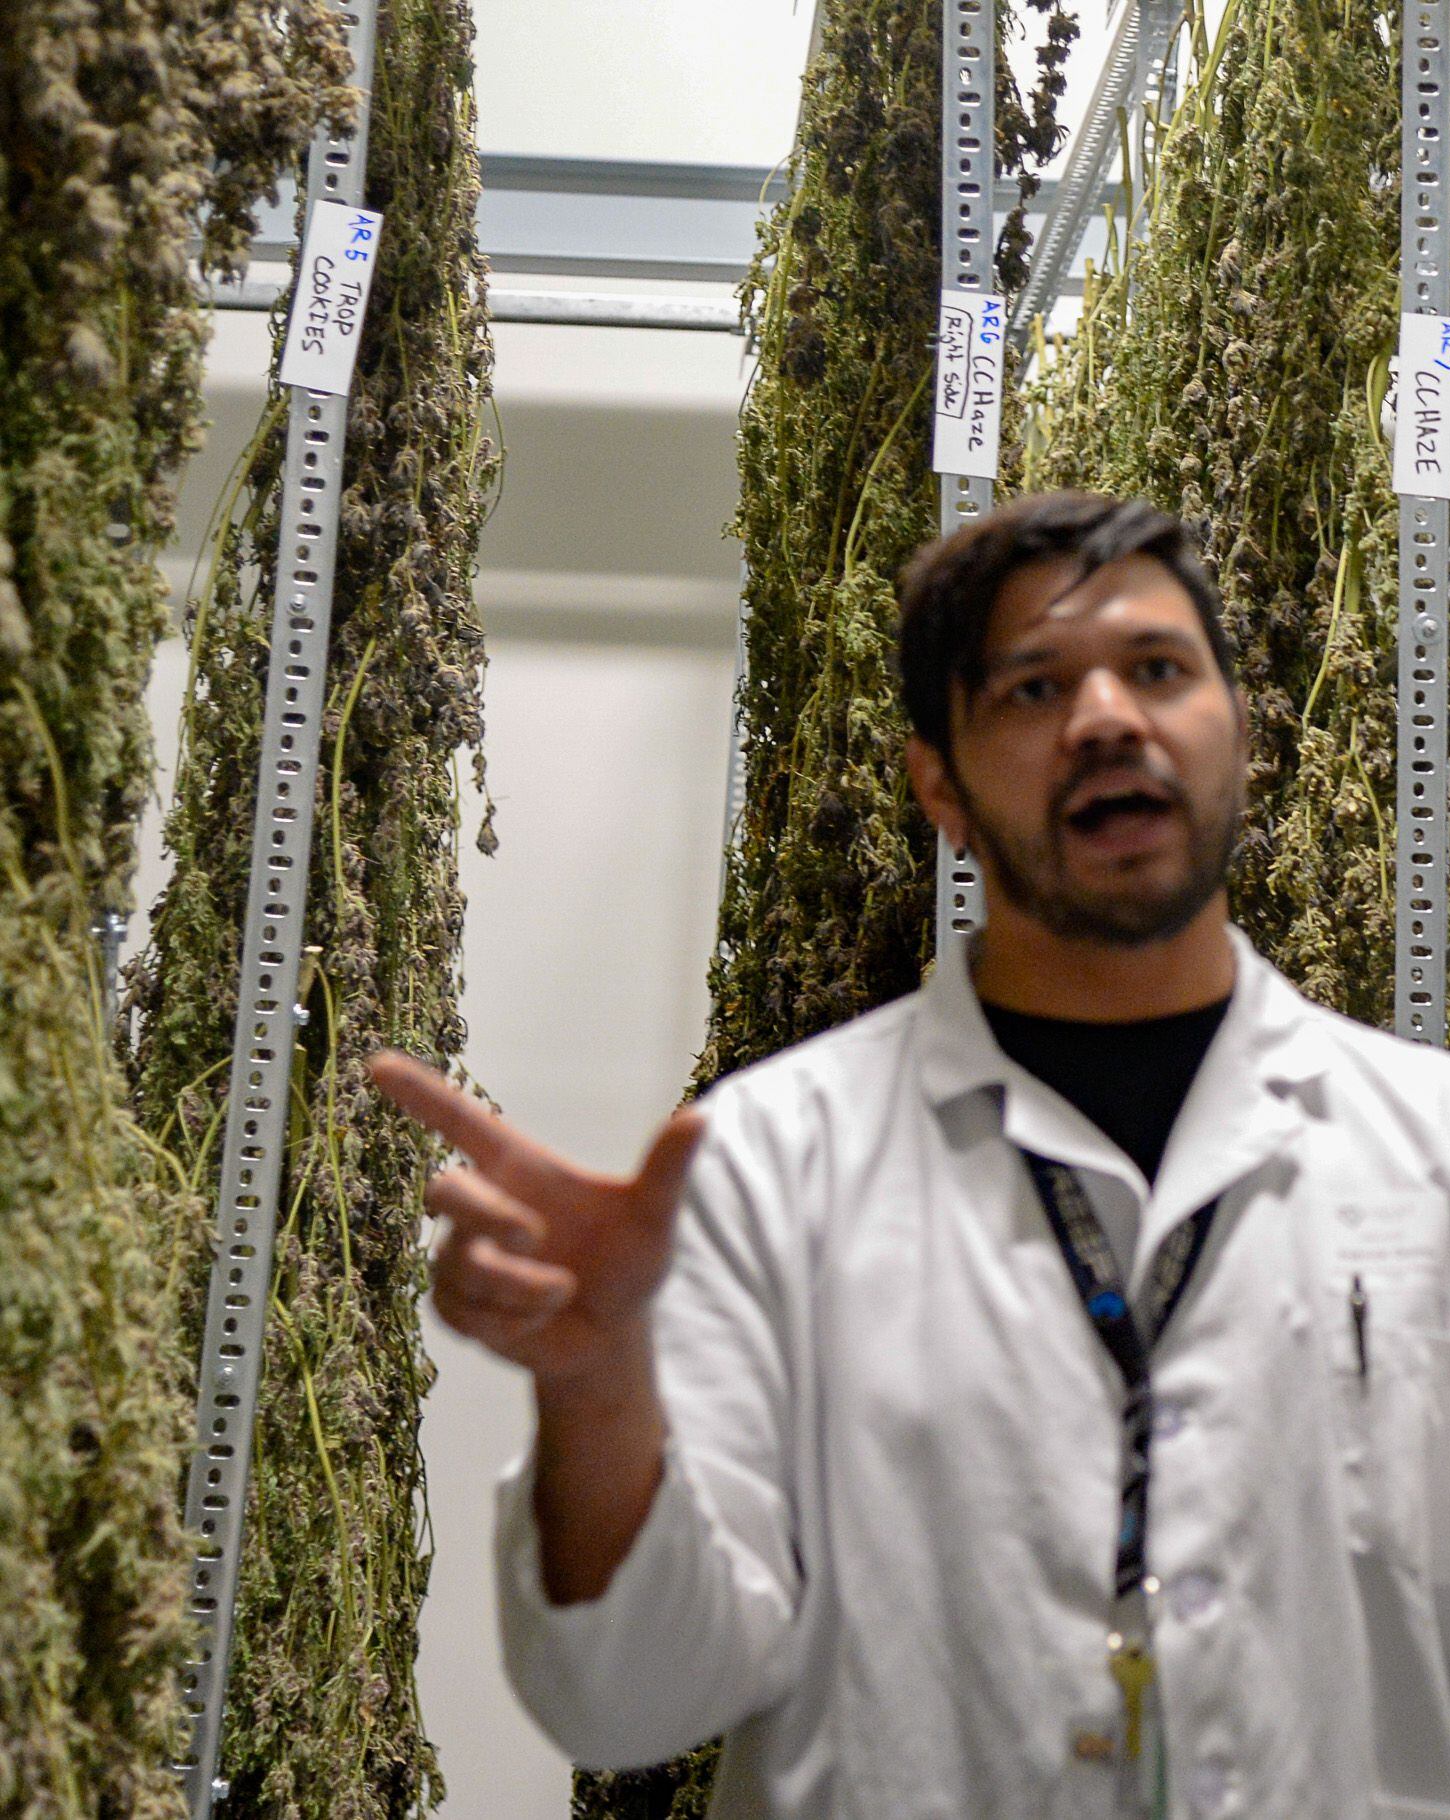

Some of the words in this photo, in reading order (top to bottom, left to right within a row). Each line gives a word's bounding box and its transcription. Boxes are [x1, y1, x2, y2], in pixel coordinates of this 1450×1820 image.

[301, 255, 336, 355] COOKIES
[331, 281, 362, 336] TROP
[940, 315, 965, 362] Right
[943, 372, 963, 410] Side
